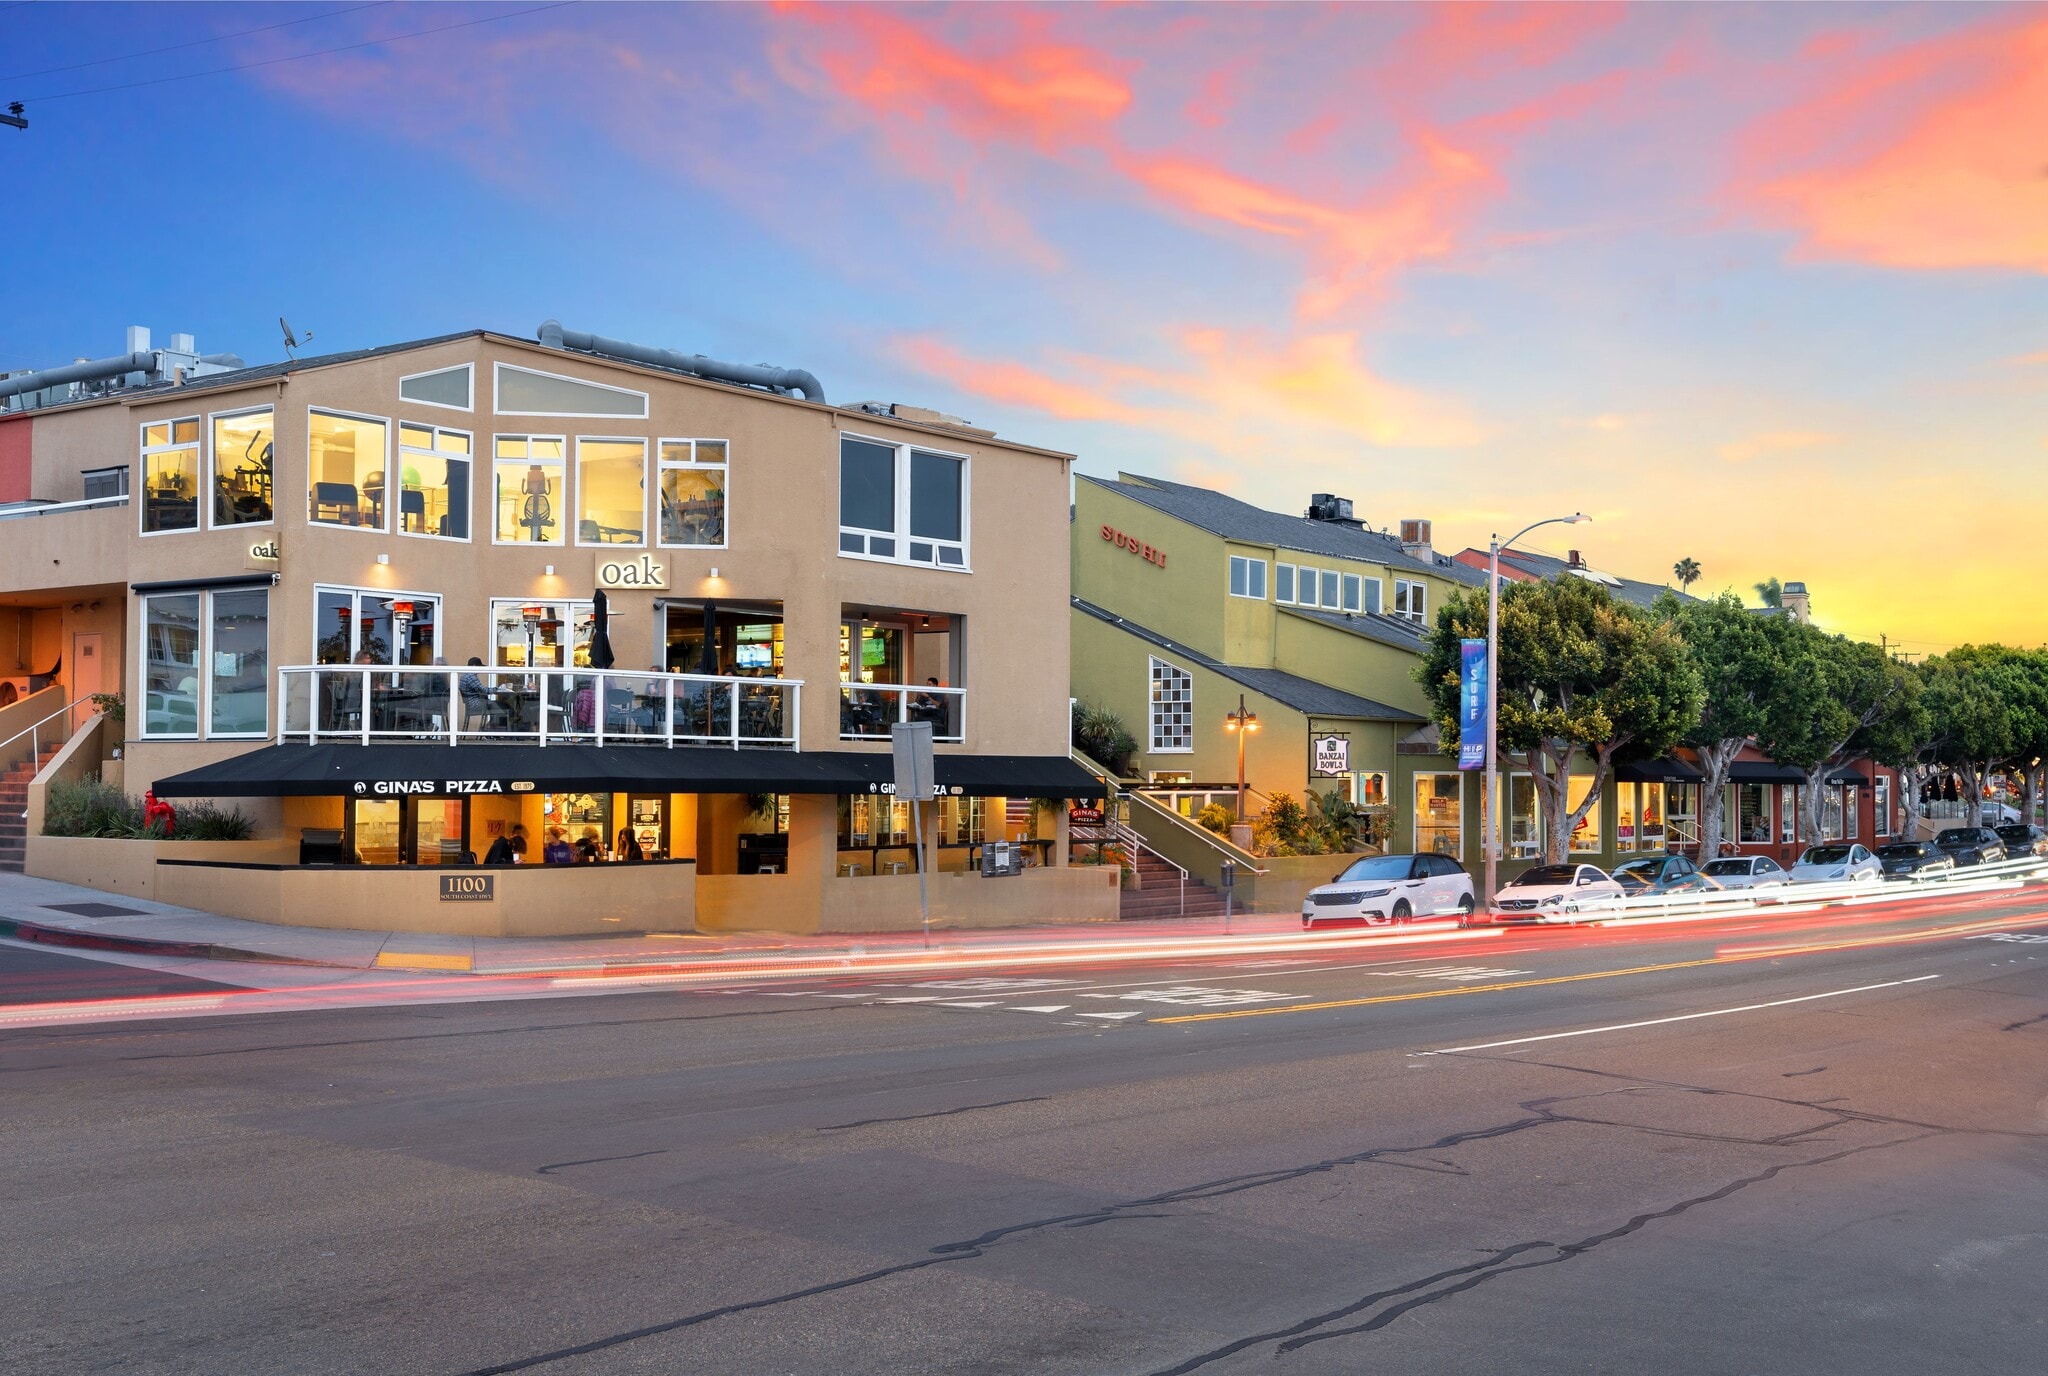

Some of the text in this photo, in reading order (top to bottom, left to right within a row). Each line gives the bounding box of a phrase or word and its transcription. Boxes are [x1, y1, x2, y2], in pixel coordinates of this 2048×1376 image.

[252, 542, 280, 558] oak
[1101, 525, 1166, 568] SUSHI
[602, 556, 662, 584] oak
[1470, 669, 1478, 719] SURF
[1318, 752, 1345, 760] BANZAI
[374, 780, 502, 794] GINA'S PIZZA
[448, 877, 486, 892] 1100
